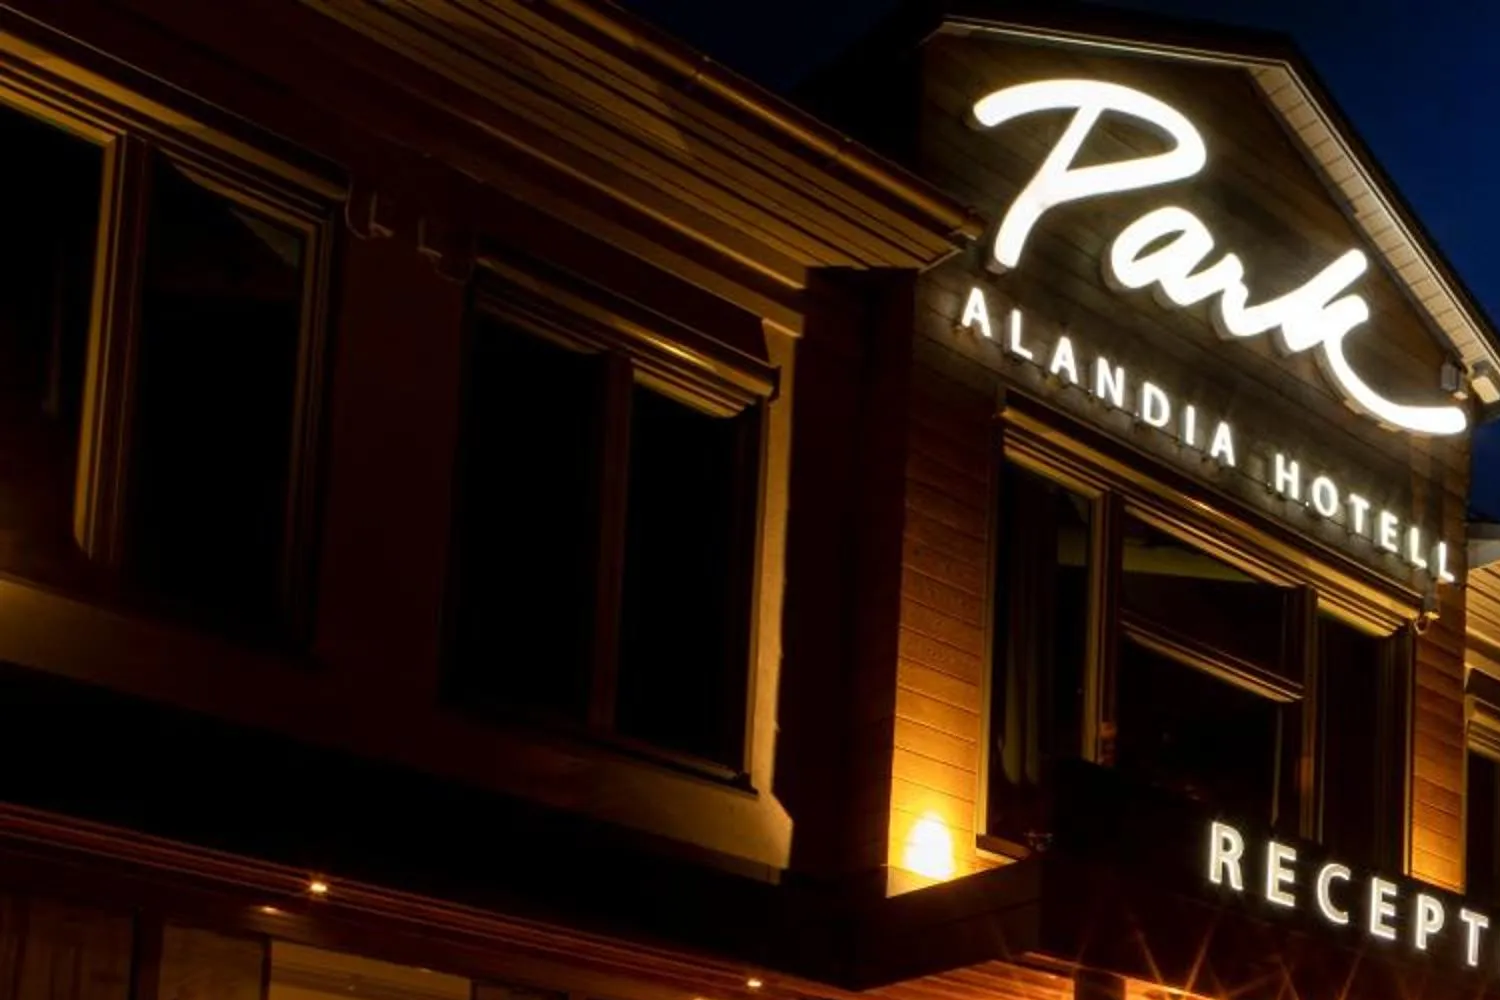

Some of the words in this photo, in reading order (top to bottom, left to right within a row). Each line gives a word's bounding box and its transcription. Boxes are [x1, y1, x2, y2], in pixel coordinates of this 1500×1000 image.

[972, 79, 1467, 435] Park
[961, 287, 1236, 467] ALANDIA
[1274, 453, 1455, 583] HOTELL
